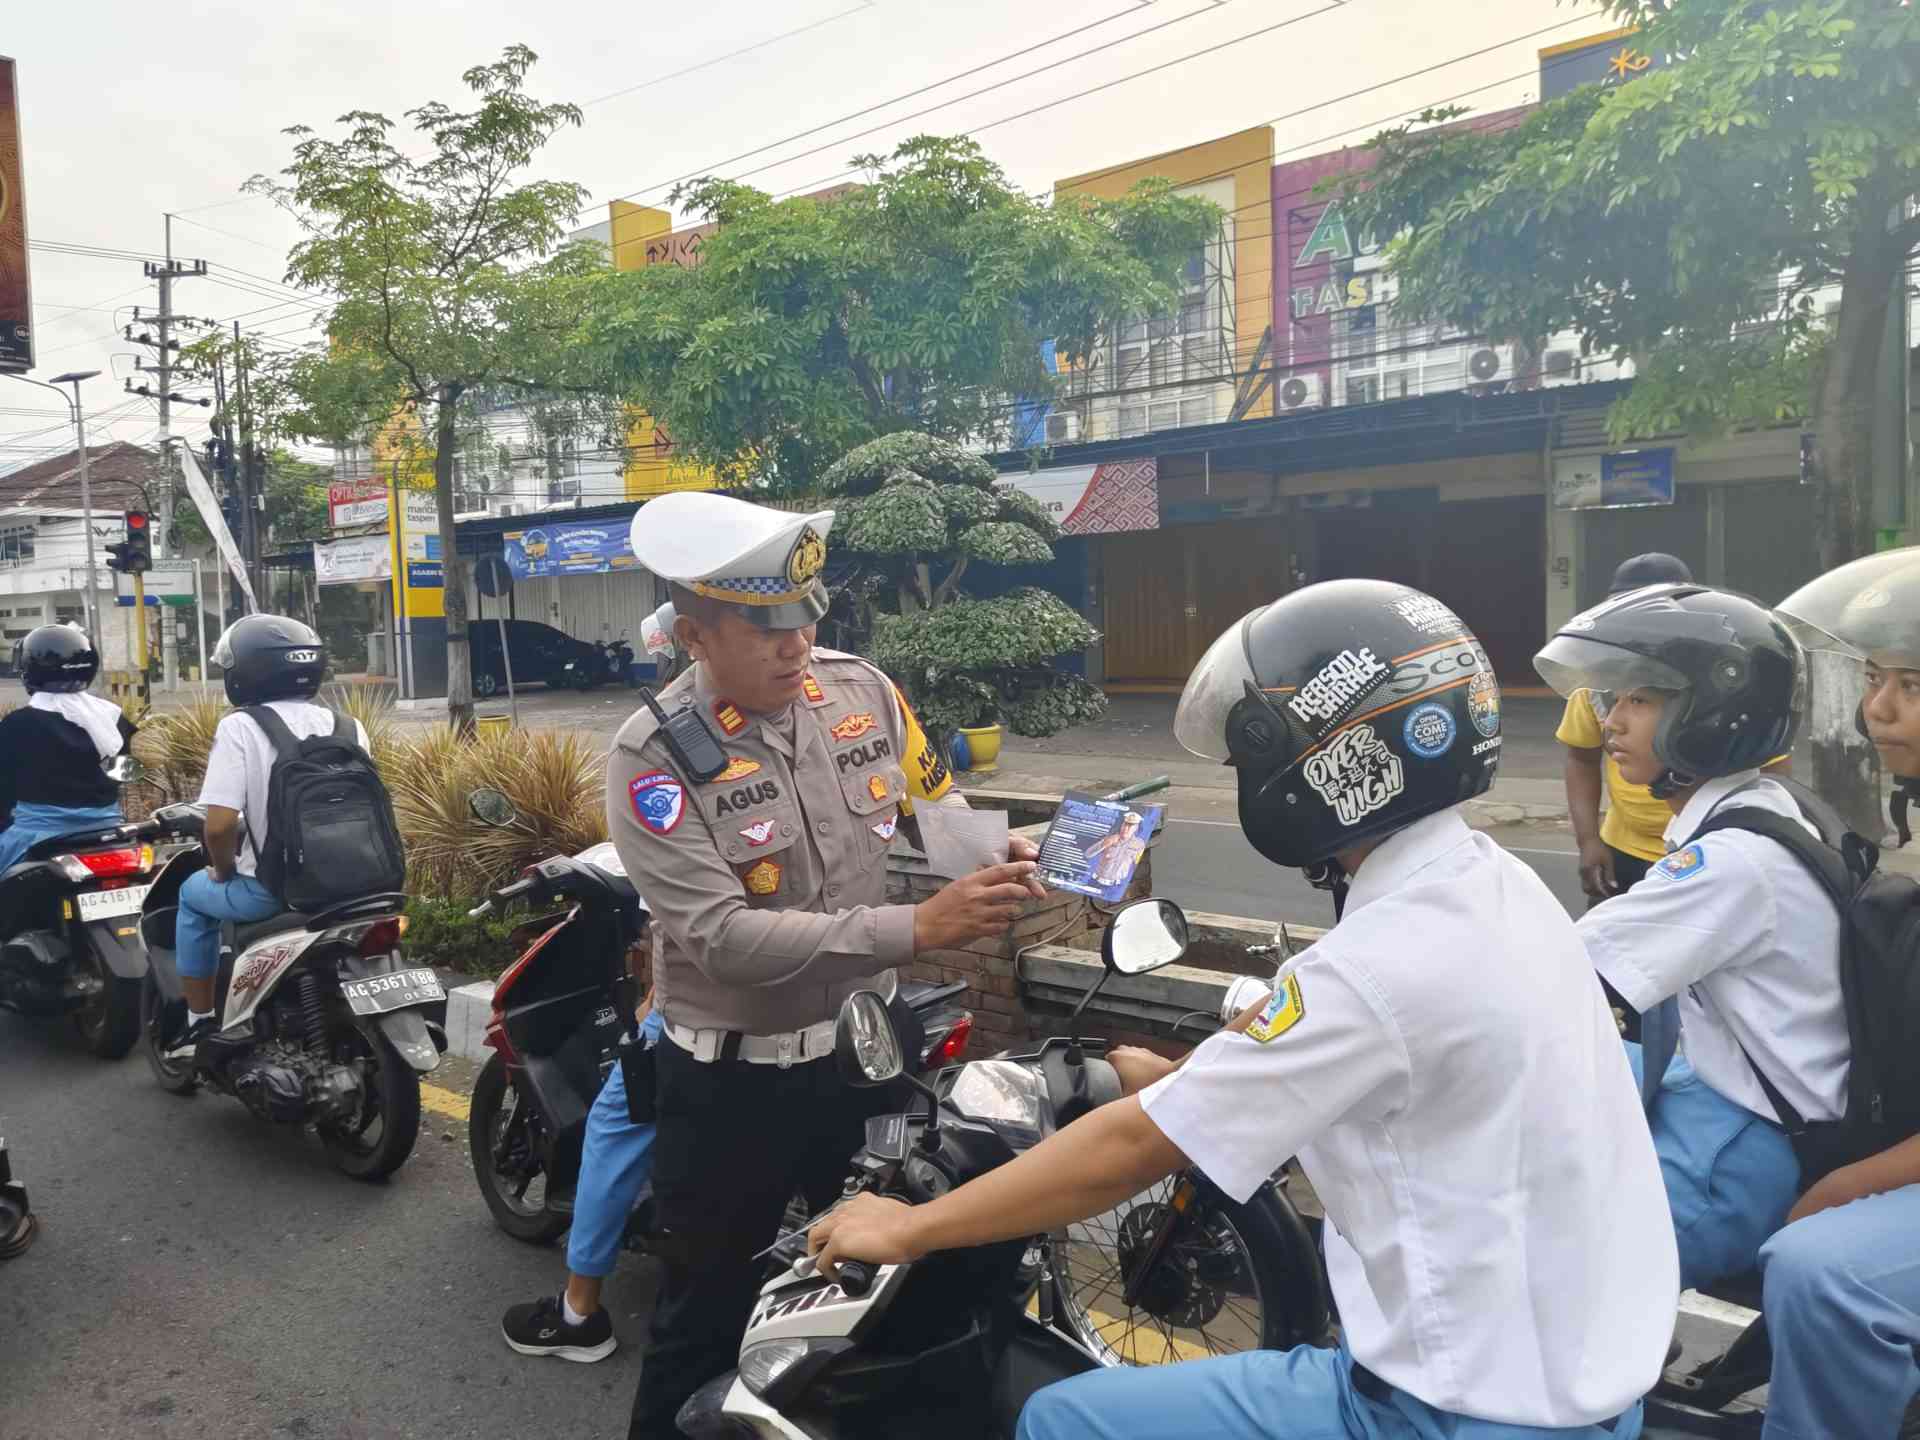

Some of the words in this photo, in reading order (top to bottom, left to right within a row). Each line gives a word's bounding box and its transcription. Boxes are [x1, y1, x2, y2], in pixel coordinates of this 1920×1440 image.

[292, 651, 314, 660] KYT
[1414, 721, 1448, 738] COME
[836, 737, 891, 774] POLRI
[1308, 727, 1376, 786] OVER
[716, 780, 780, 817] AGUS
[1339, 758, 1401, 821] HIGH
[348, 984, 369, 999] AG
[371, 974, 408, 995] 5367
